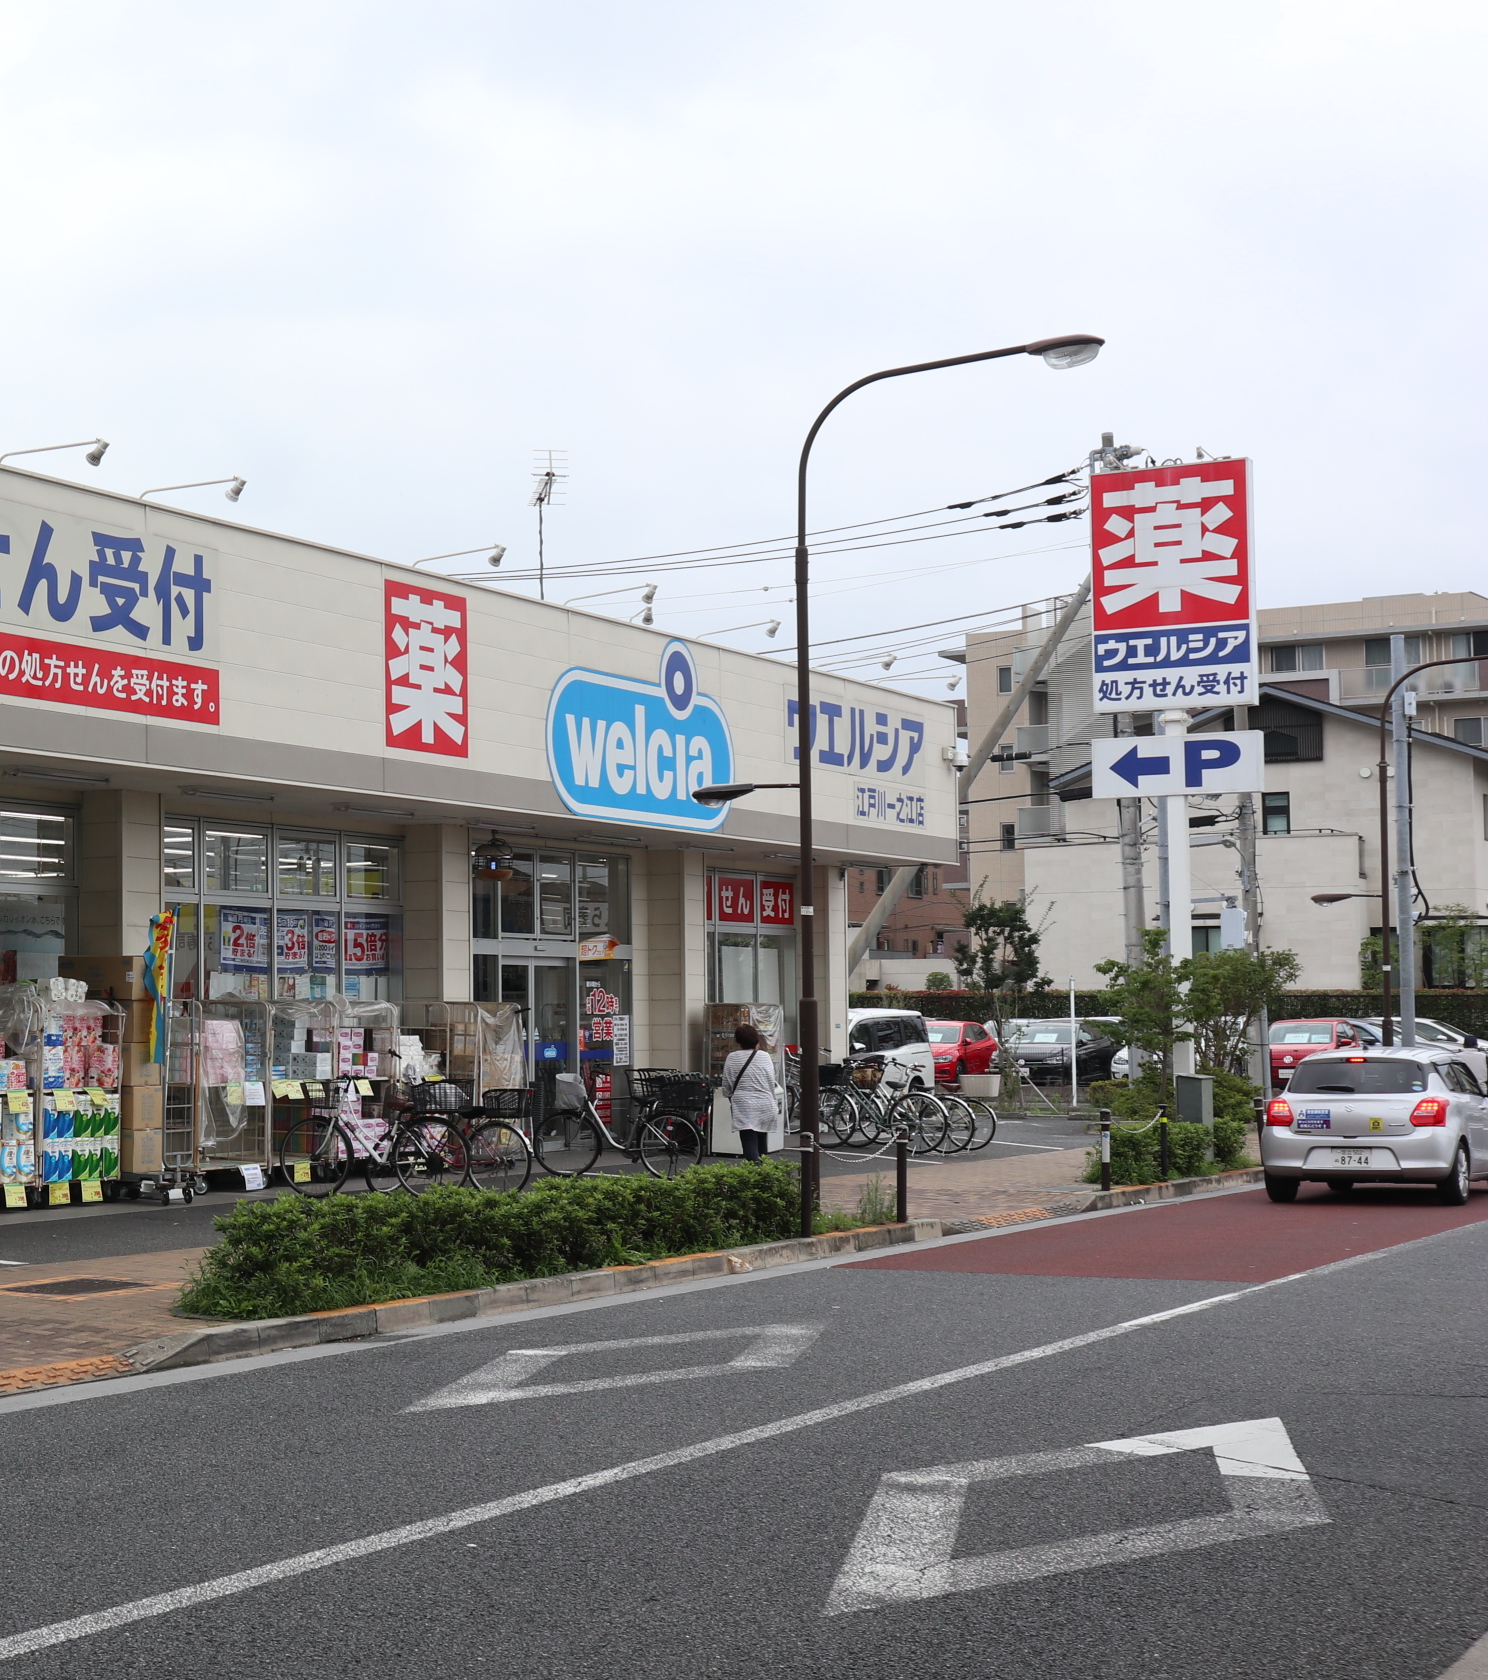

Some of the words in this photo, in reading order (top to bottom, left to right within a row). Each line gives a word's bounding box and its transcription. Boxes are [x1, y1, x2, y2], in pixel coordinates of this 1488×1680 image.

[1097, 476, 1244, 615] 薬
[389, 594, 465, 745] 薬
[1097, 630, 1247, 667] ウエルシア
[1098, 671, 1248, 702] 処方せん受付
[565, 704, 713, 803] welcia
[787, 699, 924, 777] ウエルシア
[1184, 739, 1241, 787] P
[856, 786, 924, 826] 江戸川一之江店
[720, 885, 750, 915] せん
[762, 888, 790, 918] 受付
[1340, 1156, 1369, 1165] 87-44
